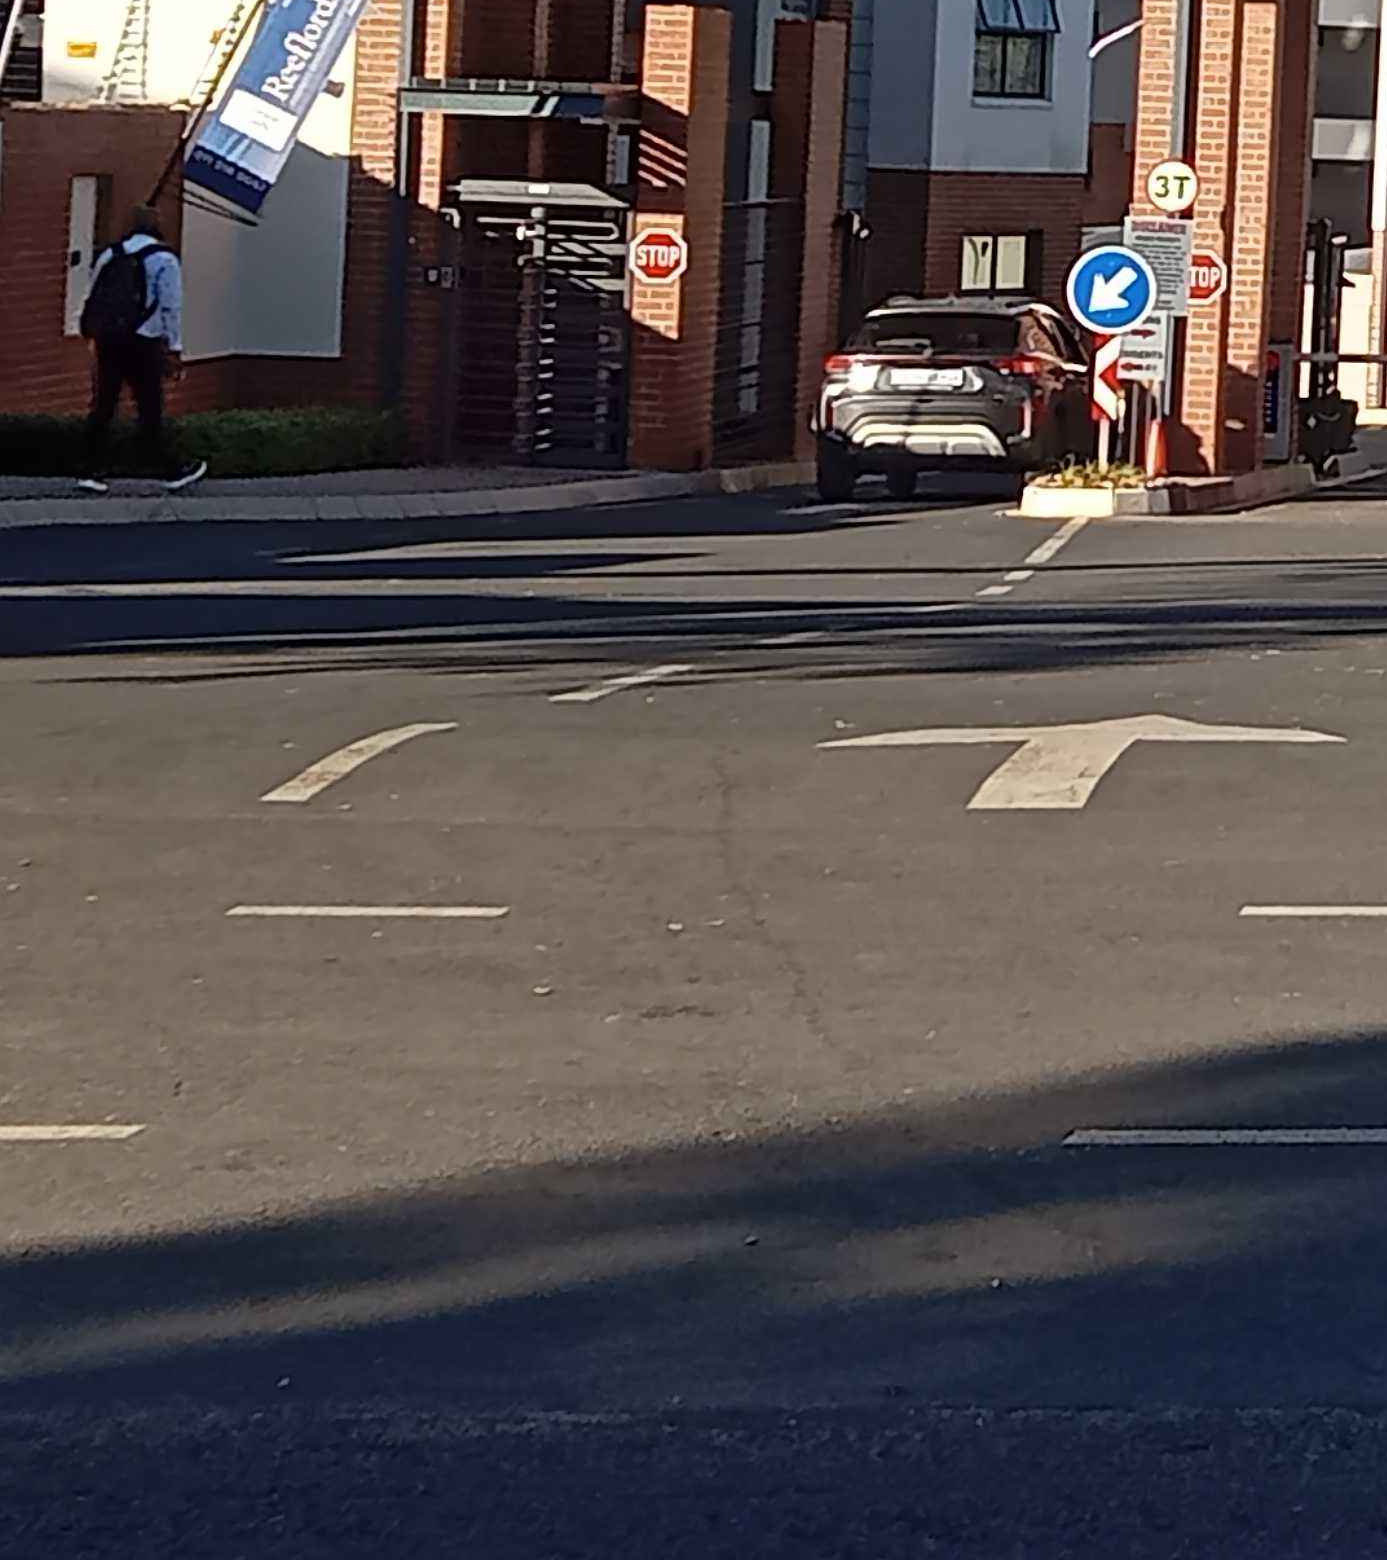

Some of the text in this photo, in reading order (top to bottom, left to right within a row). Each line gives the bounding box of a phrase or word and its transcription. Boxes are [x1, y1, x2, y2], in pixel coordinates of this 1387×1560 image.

[1154, 175, 1191, 200] 3T
[637, 244, 680, 268] STOP
[1189, 266, 1221, 289] TOP
